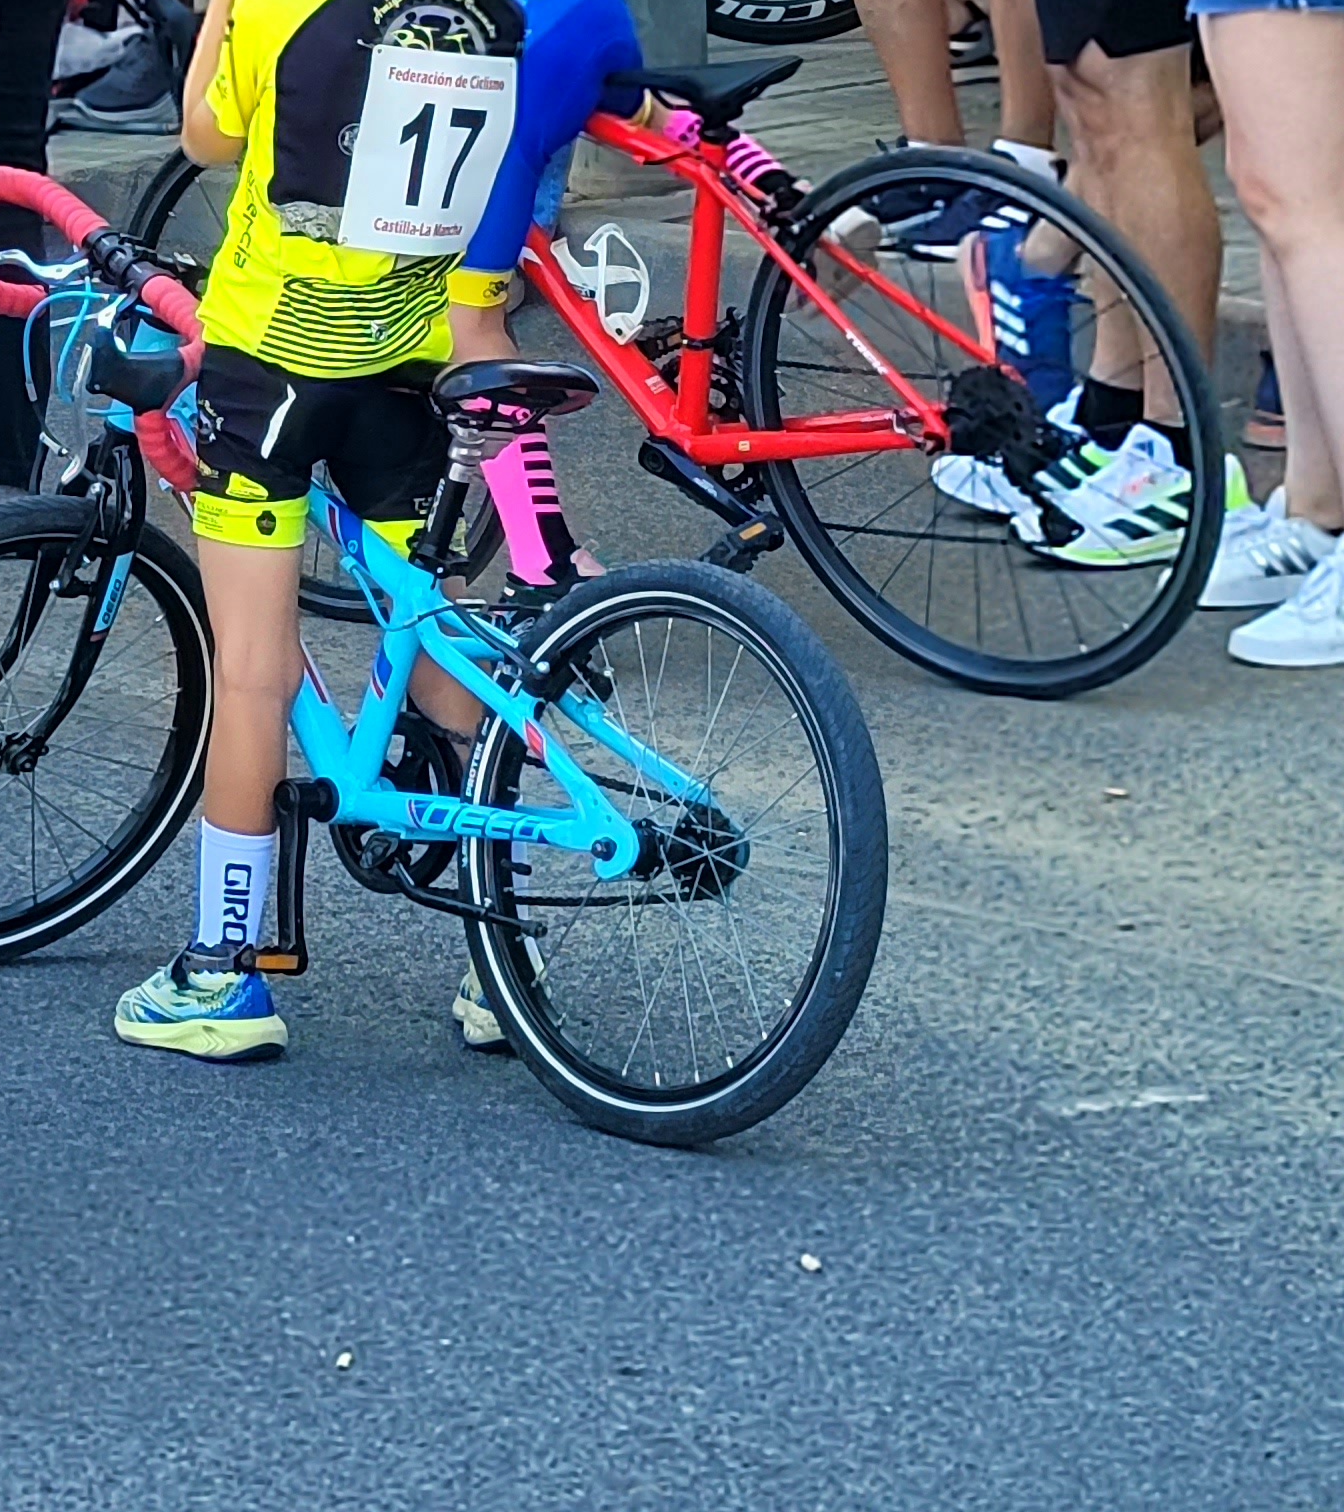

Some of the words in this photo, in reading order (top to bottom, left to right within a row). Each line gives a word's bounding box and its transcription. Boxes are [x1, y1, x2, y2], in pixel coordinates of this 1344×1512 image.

[388, 66, 453, 88] Federación
[454, 74, 469, 89] de
[469, 75, 506, 91] Ciclismo
[399, 102, 488, 209] 17
[373, 216, 432, 238] Castilla-La
[465, 741, 484, 798] PROTEK
[222, 862, 252, 947] GIRO
